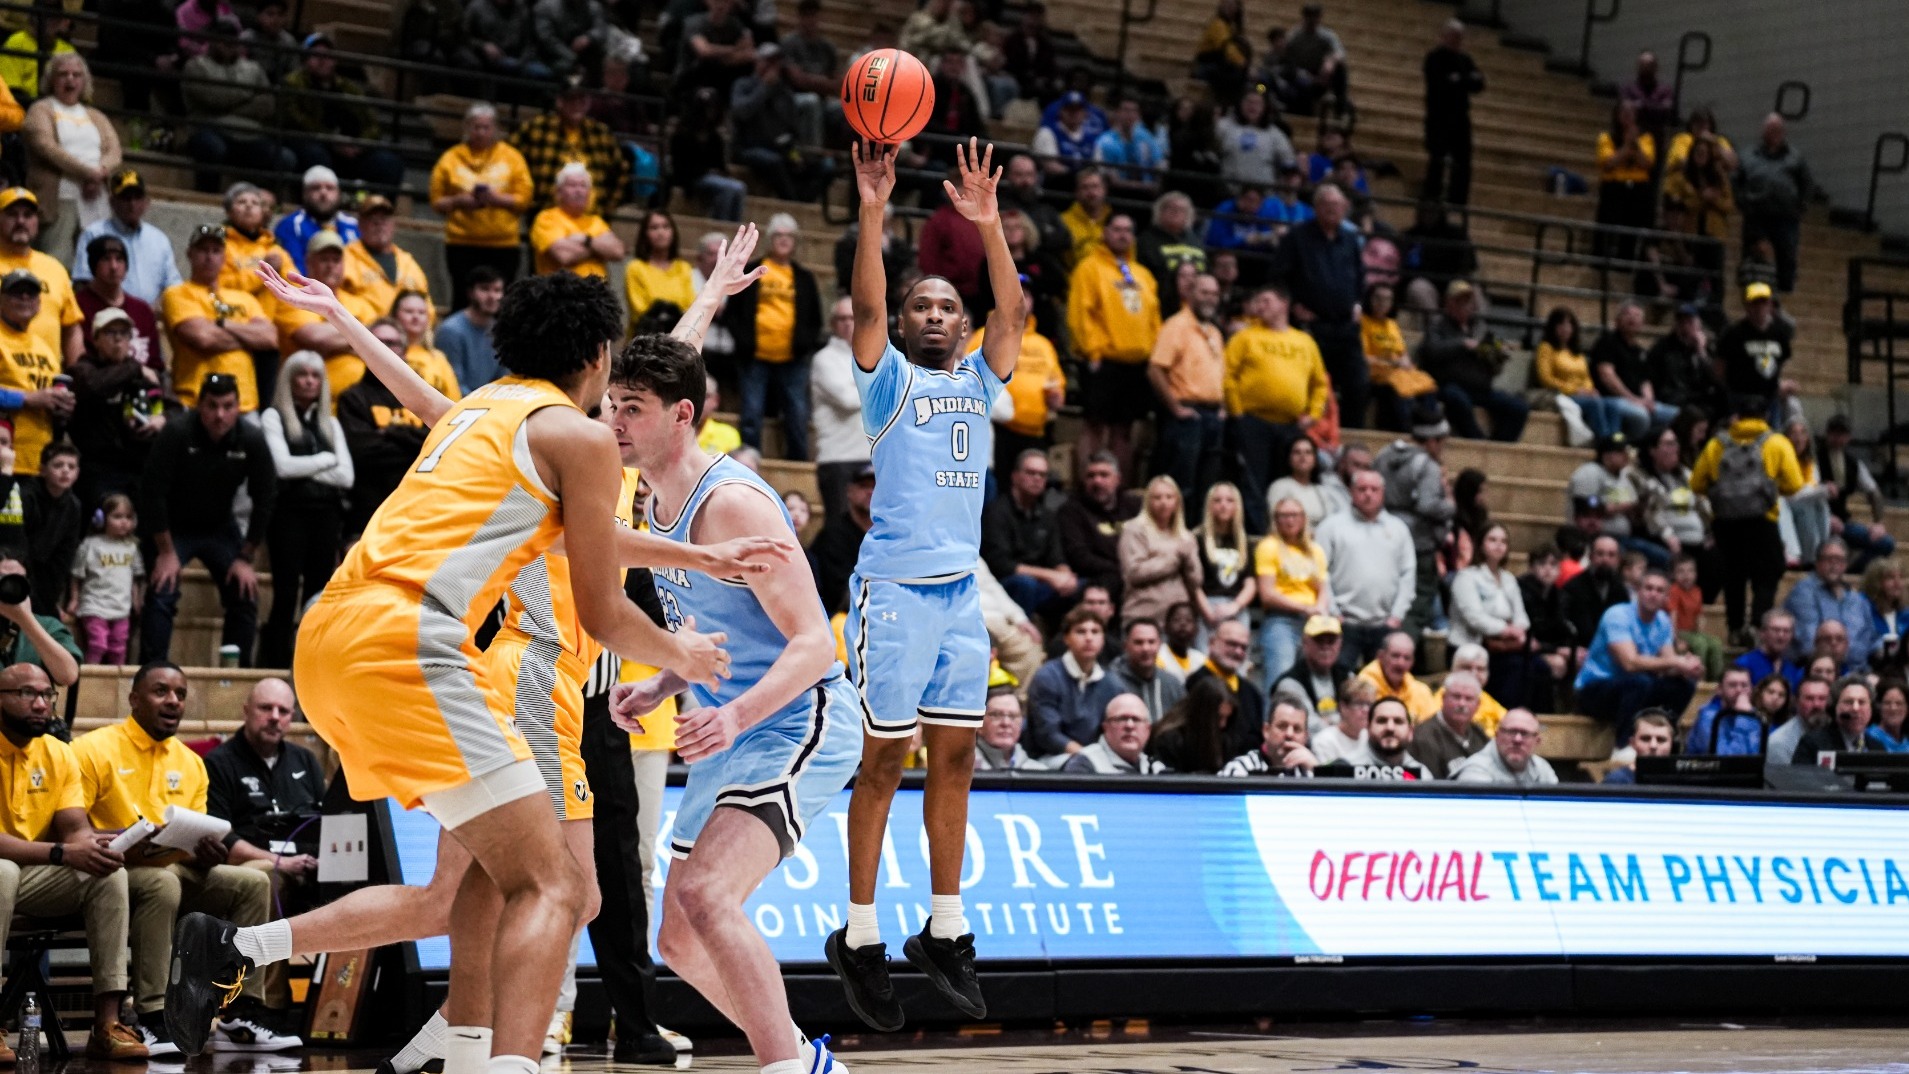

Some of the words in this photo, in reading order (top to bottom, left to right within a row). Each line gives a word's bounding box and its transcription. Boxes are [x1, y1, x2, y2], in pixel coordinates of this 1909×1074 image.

[862, 57, 885, 102] ELITE
[414, 407, 491, 473] 7
[951, 421, 969, 461] 0
[935, 470, 979, 489] STATE
[99, 552, 135, 567] VALP
[1309, 849, 1490, 902] OFFICIAL
[1491, 851, 1650, 902] TEAM
